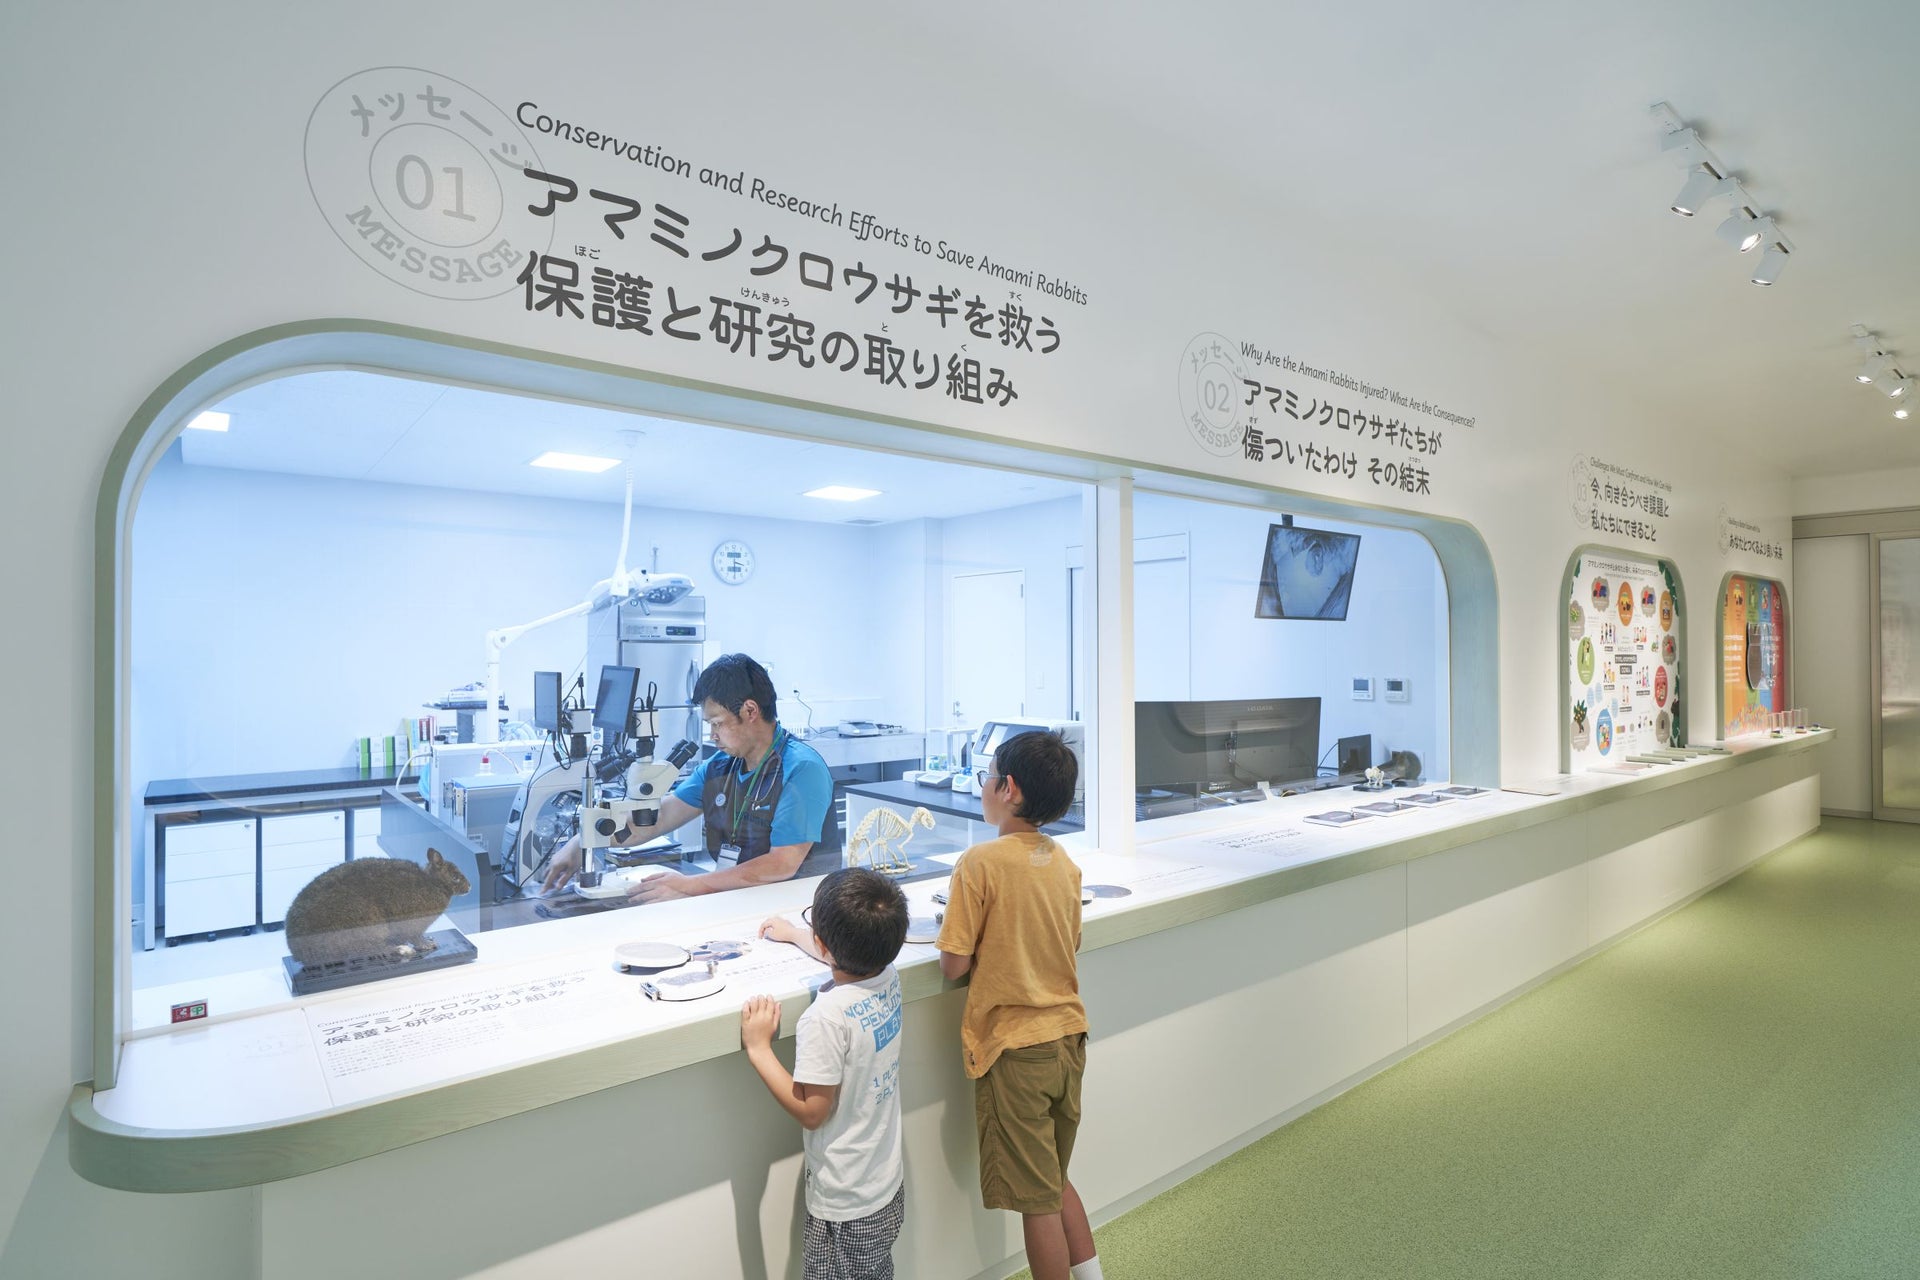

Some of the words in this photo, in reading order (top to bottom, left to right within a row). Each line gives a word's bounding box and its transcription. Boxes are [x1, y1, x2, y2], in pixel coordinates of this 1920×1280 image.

[350, 85, 533, 170] メッセージ
[395, 154, 476, 222] 01
[516, 101, 691, 178] Conservation
[699, 172, 744, 195] and
[750, 178, 842, 226] Research
[849, 211, 908, 248] Efforts
[914, 234, 931, 255] to
[936, 240, 974, 269] Save
[978, 256, 1033, 288] Amami
[1036, 274, 1088, 306] Rabbits
[345, 205, 523, 284] MESSAGE
[523, 167, 1061, 354] アマミノクロウサギを救う
[574, 244, 600, 260] ほご
[516, 250, 1018, 408] 保護と研究の取り組み
[740, 286, 791, 308] けんきゅう
[1204, 379, 1230, 413] 02
[1241, 342, 1262, 366] Why
[1264, 350, 1281, 367] Are
[1283, 356, 1297, 372] the
[1298, 361, 1328, 382] Amami
[1329, 370, 1359, 392] Rabbits
[1360, 380, 1389, 400] Injured?
[1389, 390, 1409, 408] What
[1409, 397, 1421, 412] Are
[1421, 400, 1432, 415] the
[1433, 405, 1476, 428] Consequences?
[1243, 378, 1442, 456] アマミノクロウサギたちが
[1190, 411, 1245, 448] MESSAGE
[1241, 424, 1358, 479] 傷ついたわけ
[1367, 457, 1431, 495] その結末
[1590, 477, 1670, 518] 今、向き合うべき課題と
[1590, 508, 1657, 543] 私たちにできること
[322, 977, 585, 1036] アマミノクロウサギを救う
[323, 990, 570, 1046] 保護と研究の取り組み
